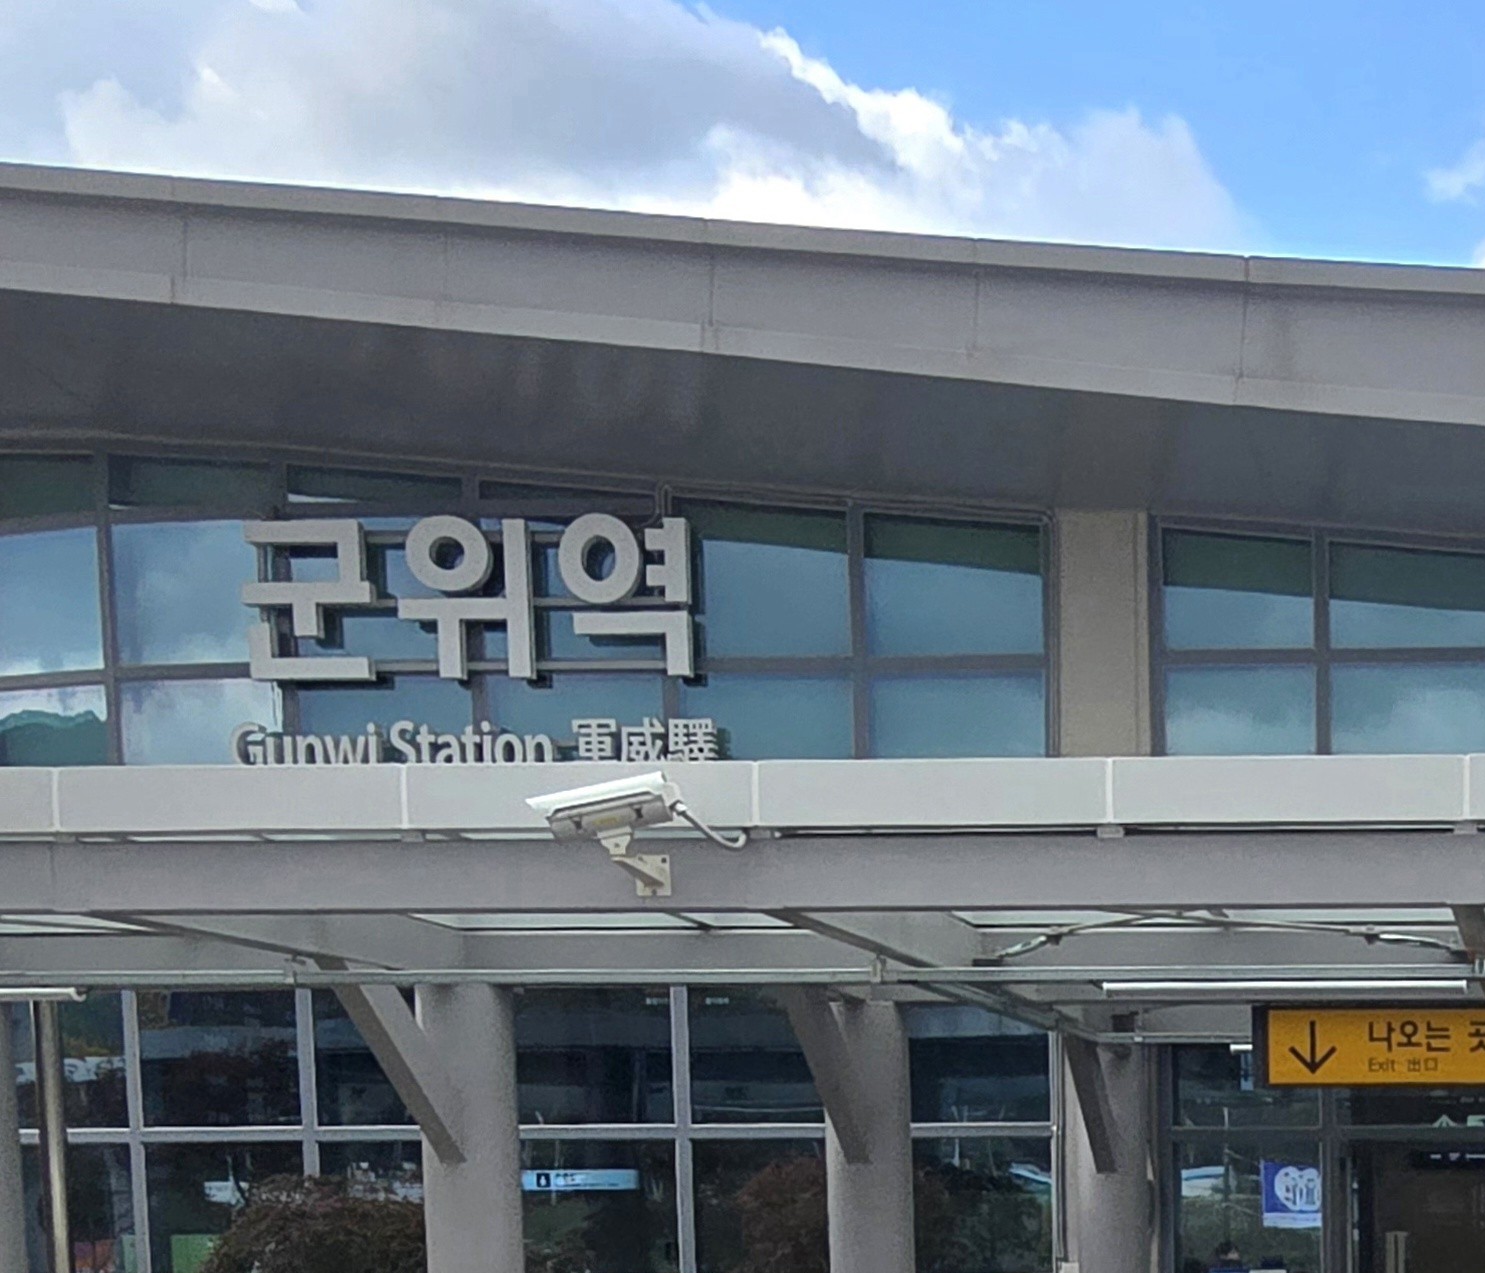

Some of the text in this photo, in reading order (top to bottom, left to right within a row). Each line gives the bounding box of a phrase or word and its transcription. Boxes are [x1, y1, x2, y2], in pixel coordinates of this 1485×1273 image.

[242, 513, 694, 681] 군위역
[230, 719, 555, 765] Gunwi Station
[1368, 1020, 1451, 1052] 나오는
[1368, 1058, 1396, 1072] Exit
[1407, 1058, 1438, 1072] 出口
